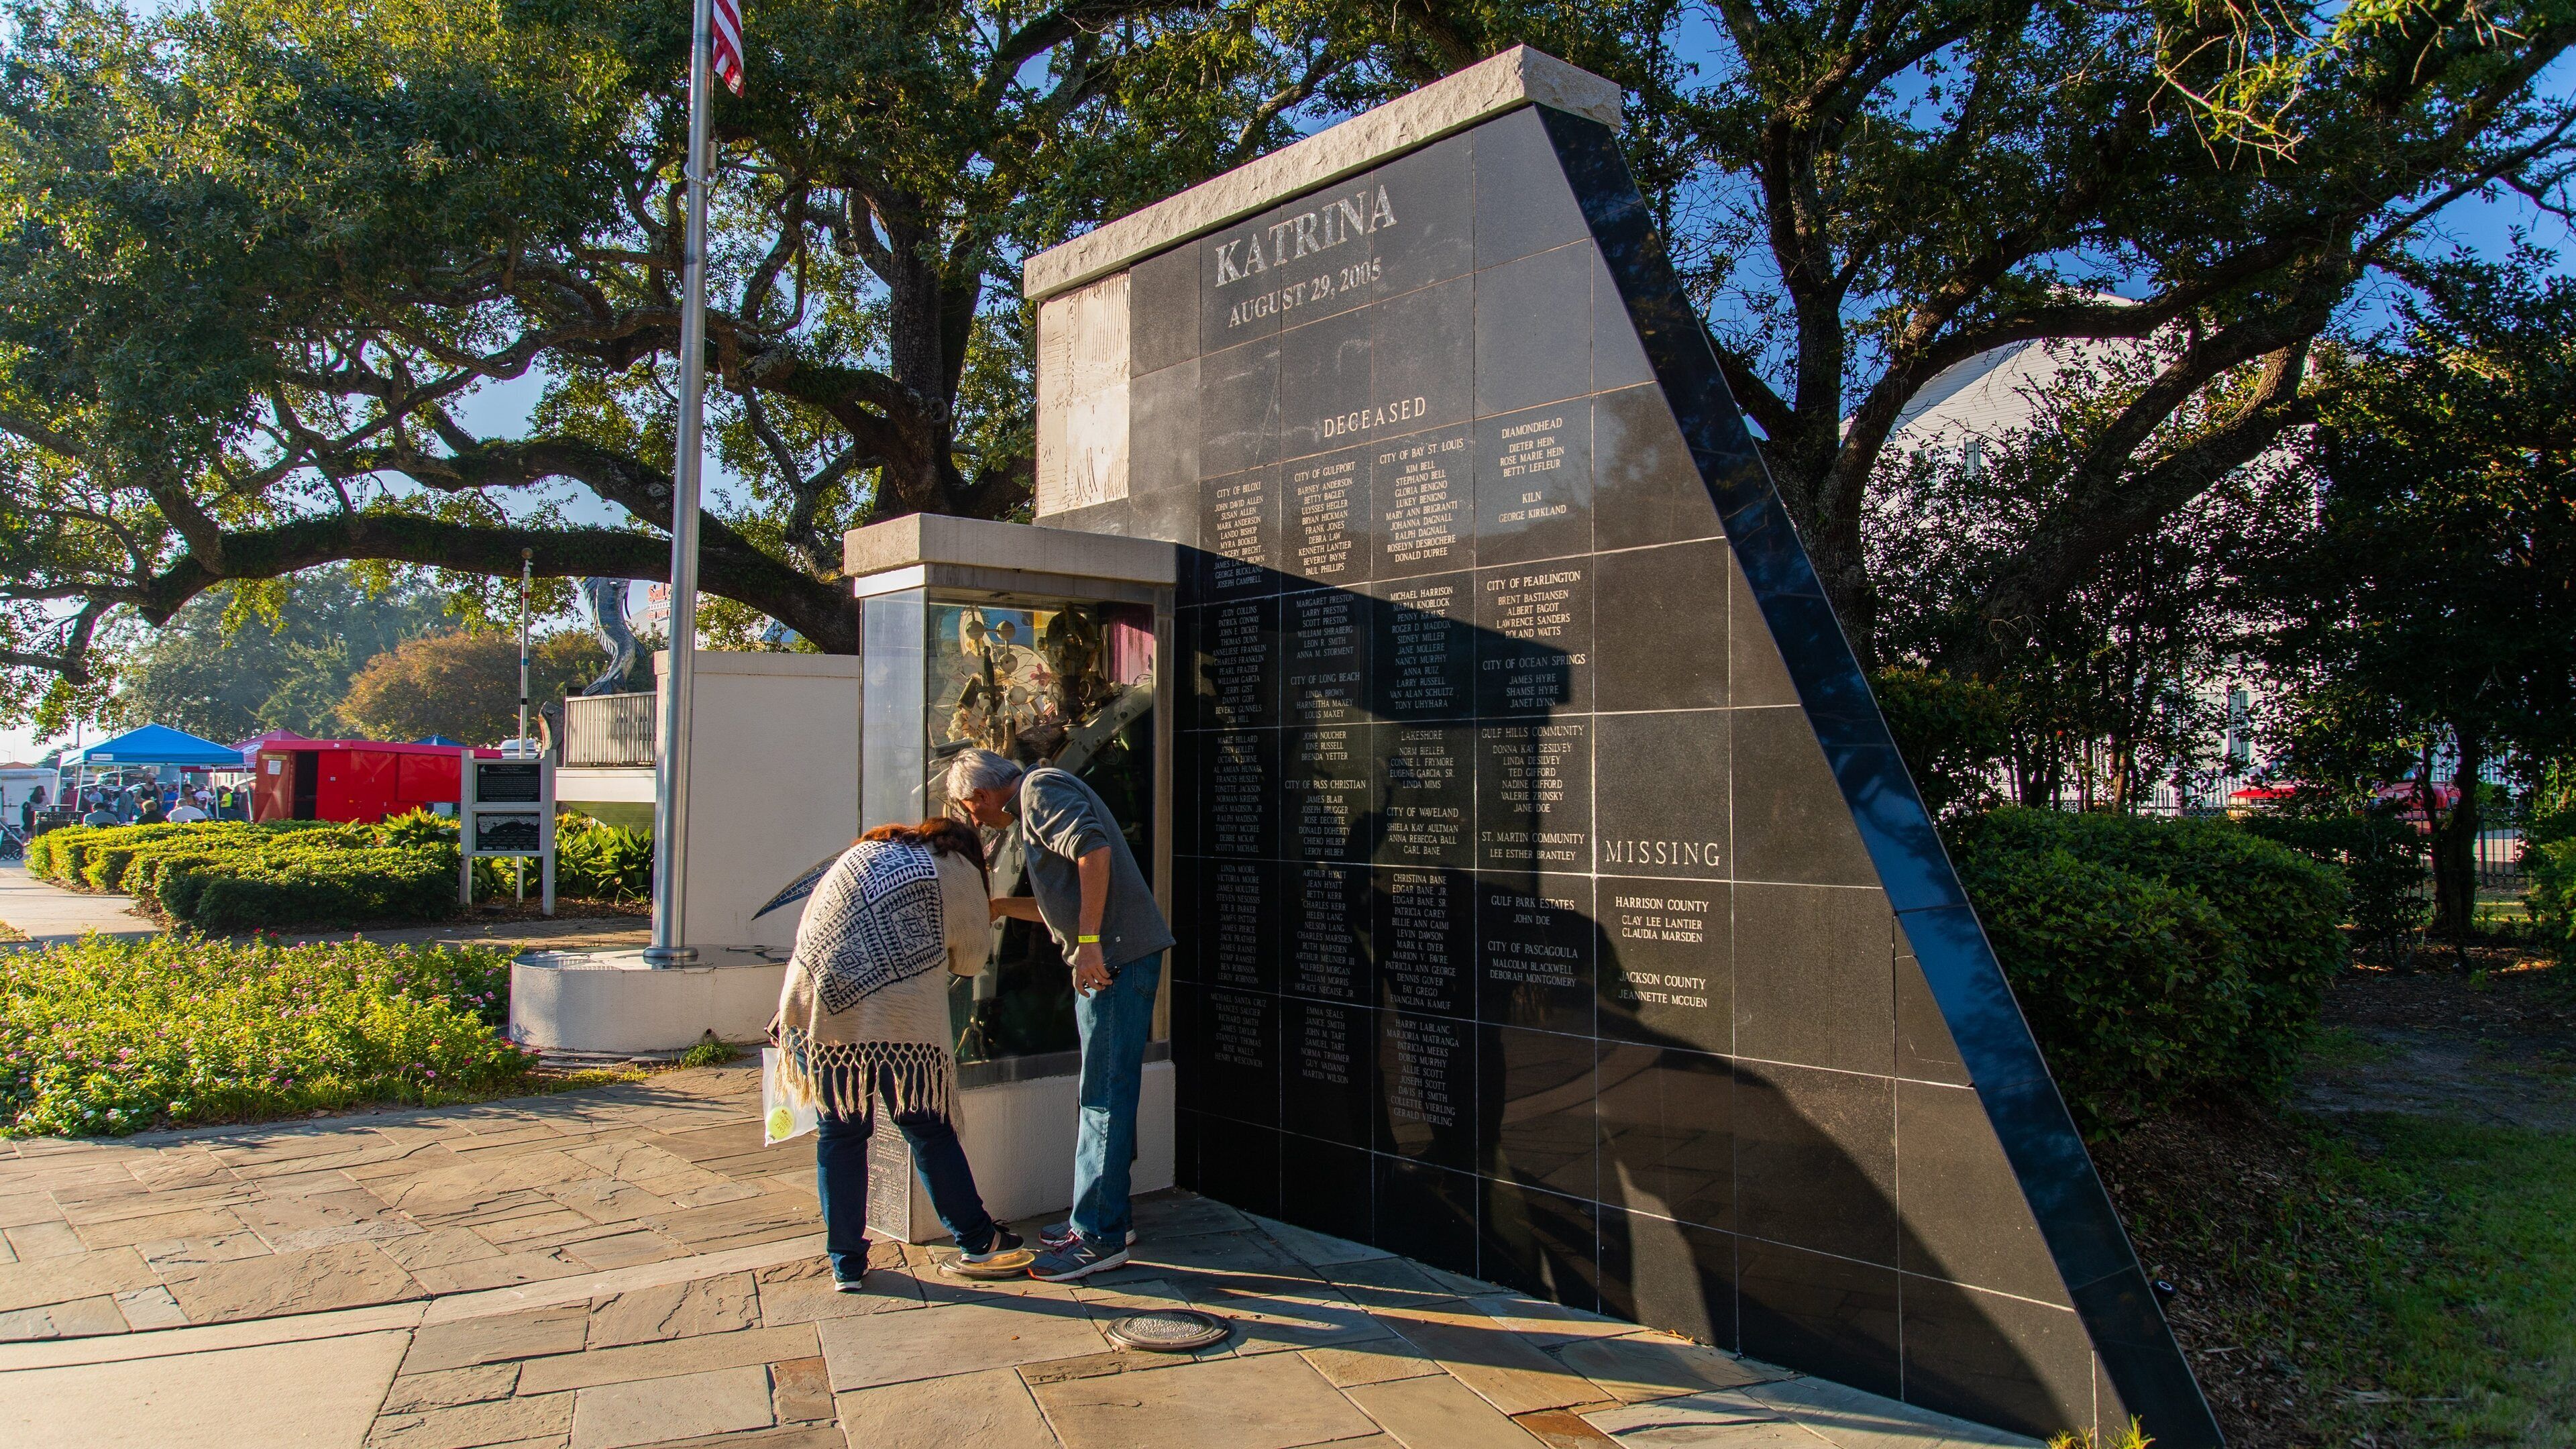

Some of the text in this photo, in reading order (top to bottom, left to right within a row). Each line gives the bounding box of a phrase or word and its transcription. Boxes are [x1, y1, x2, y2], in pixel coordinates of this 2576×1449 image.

[1215, 184, 1397, 287] KATRINA
[1228, 258, 1381, 327] AUGUST 29, 2005
[1324, 397, 1426, 437] DECEASED
[1501, 417, 1562, 438] DIAMONDHEAD
[1379, 452, 1396, 464] CITY
[1399, 449, 1408, 460] OF
[1411, 447, 1424, 457] BAY
[1442, 438, 1463, 451] LOUIS
[1509, 436, 1554, 453] DIETER HEIN
[1500, 446, 1564, 466] ROSE MARIE HEIN
[1294, 461, 1356, 482] CITY OF GULFPORT
[1406, 460, 1435, 473] KIM BELL
[1503, 459, 1560, 477] BETTY LEFLEUR
[1395, 469, 1446, 486] STEPHANO BELL
[1217, 481, 1261, 498] CITY OF BILOXI
[1297, 477, 1352, 495] BARNEY ANDERSON
[1395, 480, 1448, 497] GLORIA BENIGNO
[1214, 495, 1263, 511] JOHN DAVID ALLEN
[1303, 489, 1344, 504] BETTY BAGLEY
[1396, 491, 1446, 508] LUKEY BENIGNO
[1522, 491, 1541, 503] KILN
[1221, 506, 1256, 520] SUSAN ALLEN
[1301, 499, 1348, 515] ULYSSES HEGLER
[1385, 500, 1458, 520] MARY ANN BRIGRANTI
[1498, 504, 1566, 523] GEORGE KIRKLAND
[1217, 515, 1261, 530] MARK ANDERSON
[1301, 510, 1348, 525] BRYAN HICKMAN
[1305, 521, 1344, 534] FRANK JONES
[1395, 525, 1446, 540] RALPH DAGNALL
[1220, 536, 1257, 549] MYRA BOOKER
[1308, 532, 1340, 544] DEBRA LAW
[1387, 534, 1456, 552] ROSELYN DESROCHERE
[1298, 540, 1352, 555] KENNETH LANTIER
[1395, 547, 1447, 561] DONALD DUPREE
[1303, 551, 1346, 565] BEVERLY PAYNE
[1217, 575, 1261, 588] JOSEPH CAMPBELL
[1487, 571, 1580, 591] CITY OF PEARLINGTON
[1390, 586, 1453, 600] MICHAEL HARRISON
[1498, 589, 1568, 605] BRENT BASTIANSEN
[1507, 602, 1558, 615] ALBERT FAGOT
[1496, 613, 1570, 629] LAWRENCE SANDERS
[1482, 654, 1585, 670] CITY OF OCEAN SPRINGS
[1290, 672, 1360, 685] CITY OF LONG BEACH
[1506, 685, 1558, 696] SHAMSE HYRE
[1401, 730, 1442, 740] LAKESHORE
[1481, 725, 1582, 738] GULF HILLS COMMUNITY
[1285, 780, 1366, 788] CITY OF PASS CHRISTIAN
[1501, 791, 1562, 800] VALERIE ZRINSKY
[1387, 806, 1458, 817] CITY OF WAVELAND
[1513, 803, 1550, 812] JANE DOE
[1387, 822, 1458, 833] SHIELA KAY AULTMAN
[1389, 834, 1456, 844] ANNA REBECCA BALL
[1497, 832, 1528, 842] MARTIN
[1532, 833, 1583, 843] COMMUNITY
[1403, 845, 1440, 855] CARL BANE
[1490, 849, 1574, 860] LEE ESTHER BRANTLEY
[1606, 840, 1719, 865] MISSING
[1393, 873, 1446, 883] CHRISTINA BANE
[1491, 896, 1574, 909] GULF PARK ESTATES
[1615, 896, 1708, 912] HARRISON COUNTY
[1514, 914, 1550, 924] JOHN DOE
[1621, 914, 1702, 929] CLAY LEE LANTIER
[1622, 927, 1703, 942] CLAUDIA MARSDEN
[1487, 941, 1577, 958] CITY OF PASCAGOULA
[1490, 969, 1575, 986] DEBORAH MONTGOMERY
[1619, 971, 1706, 989] JACKSON COUNTY
[1618, 989, 1707, 1007] JEANNETTE MCCUEN
[1395, 1019, 1450, 1034] HARRY LABLANC
